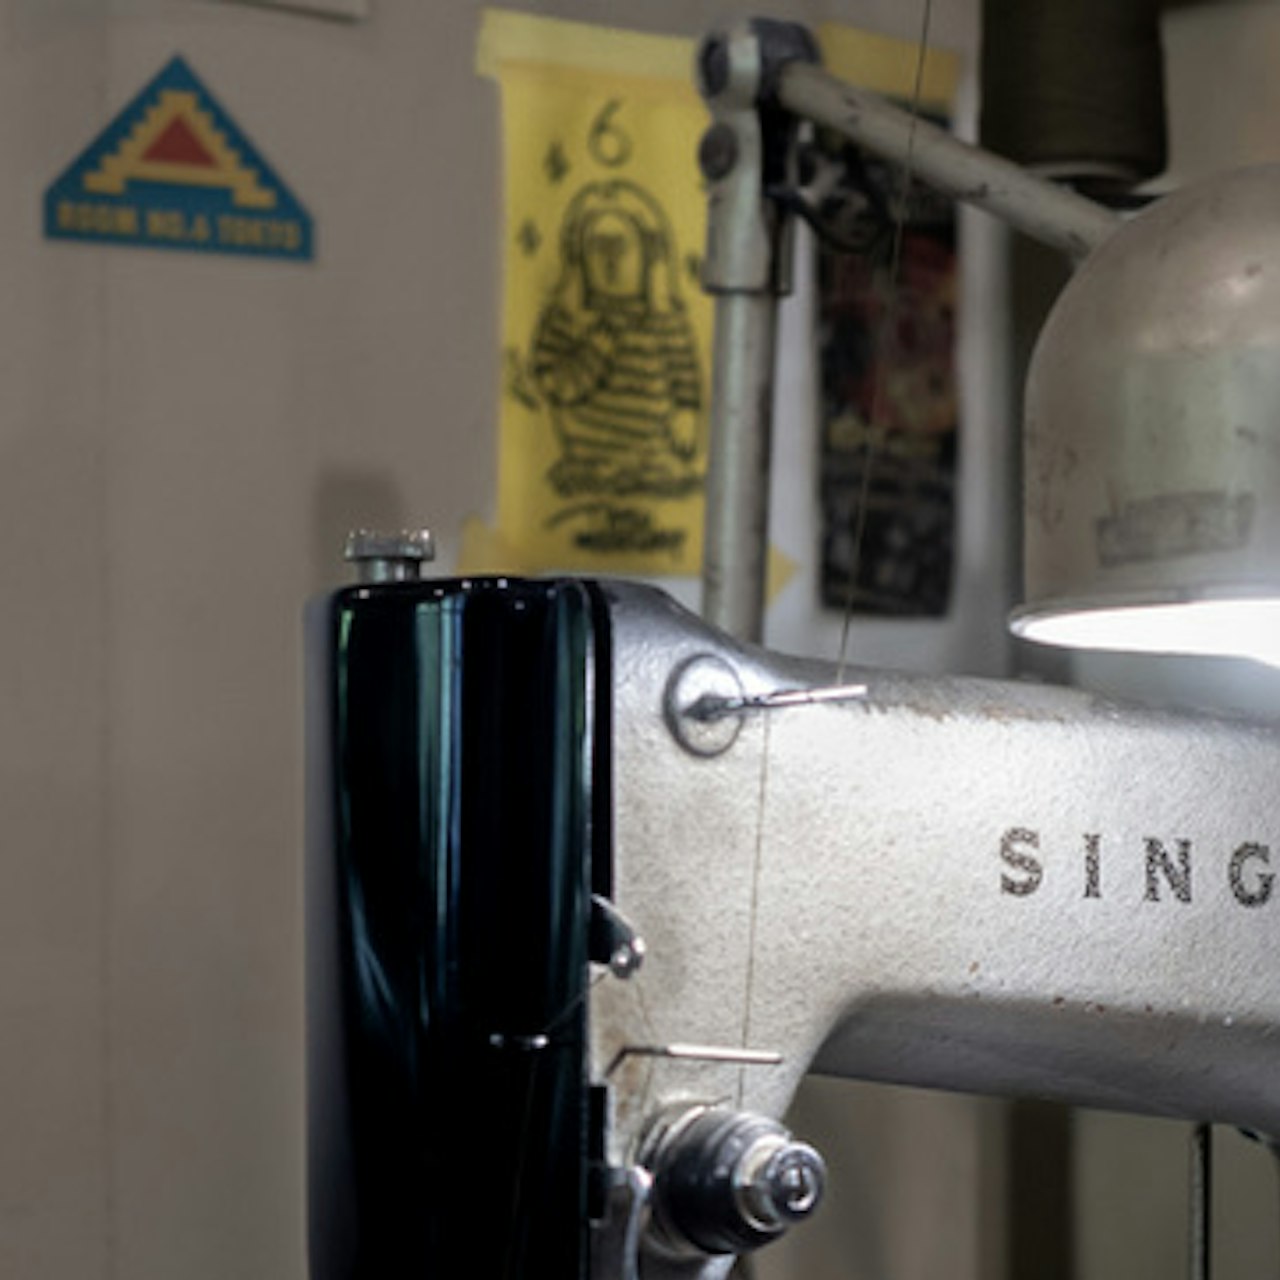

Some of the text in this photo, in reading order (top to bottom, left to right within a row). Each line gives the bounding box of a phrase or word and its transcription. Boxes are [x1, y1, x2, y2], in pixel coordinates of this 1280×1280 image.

[587, 99, 632, 167] 6
[56, 201, 138, 235] ROOM
[218, 214, 300, 250] TOKYO
